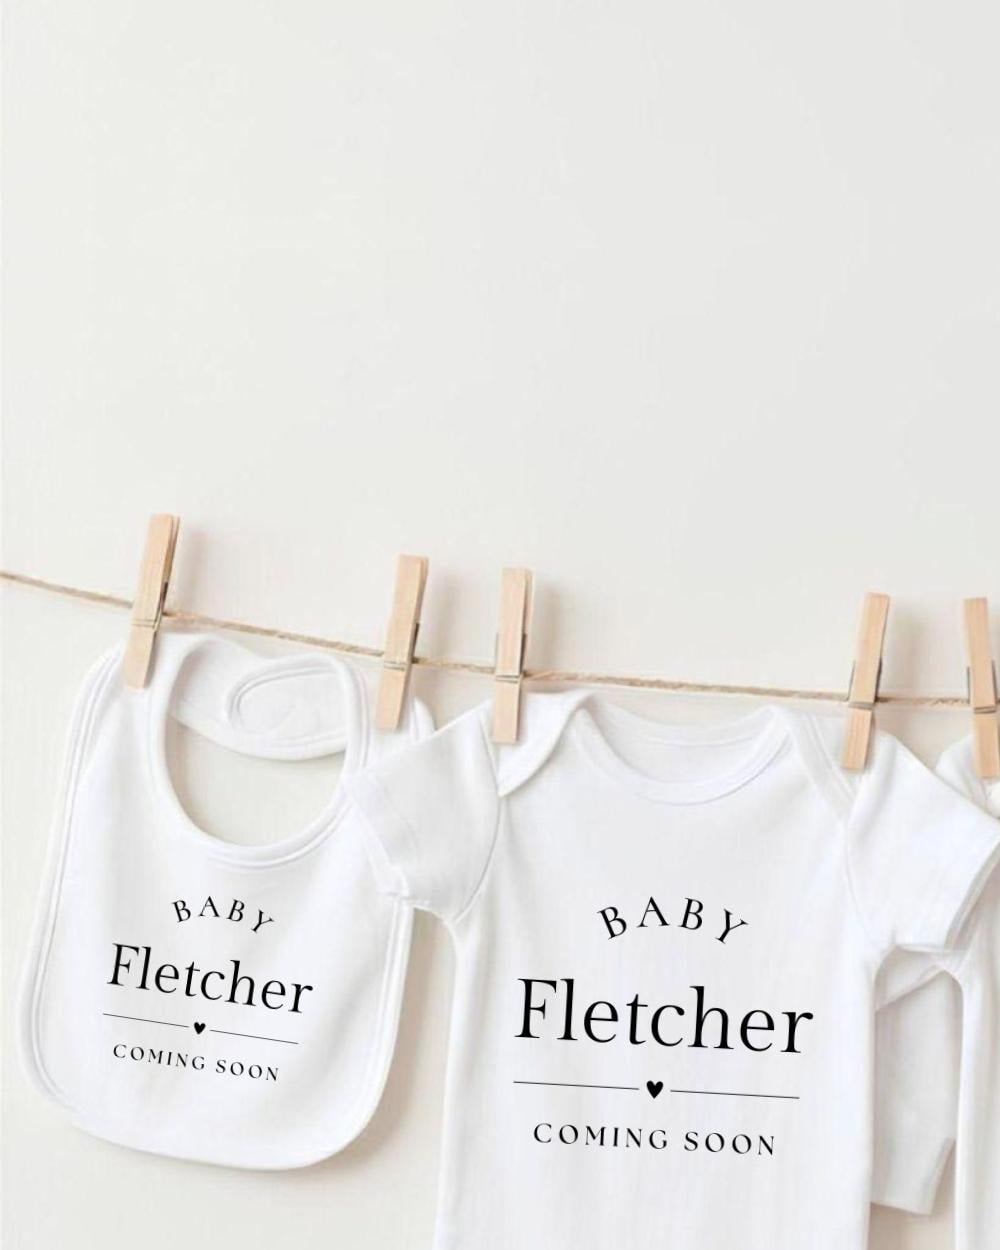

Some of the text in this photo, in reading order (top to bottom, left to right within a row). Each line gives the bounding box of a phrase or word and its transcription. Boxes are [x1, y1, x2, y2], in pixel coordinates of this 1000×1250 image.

[172, 896, 274, 933] BABY
[597, 897, 748, 944] BABY
[107, 943, 314, 1013] Fletcher
[514, 978, 813, 1053] Fletcher
[113, 1045, 278, 1081] COMING SOON
[534, 1123, 774, 1155] COMING SOON
